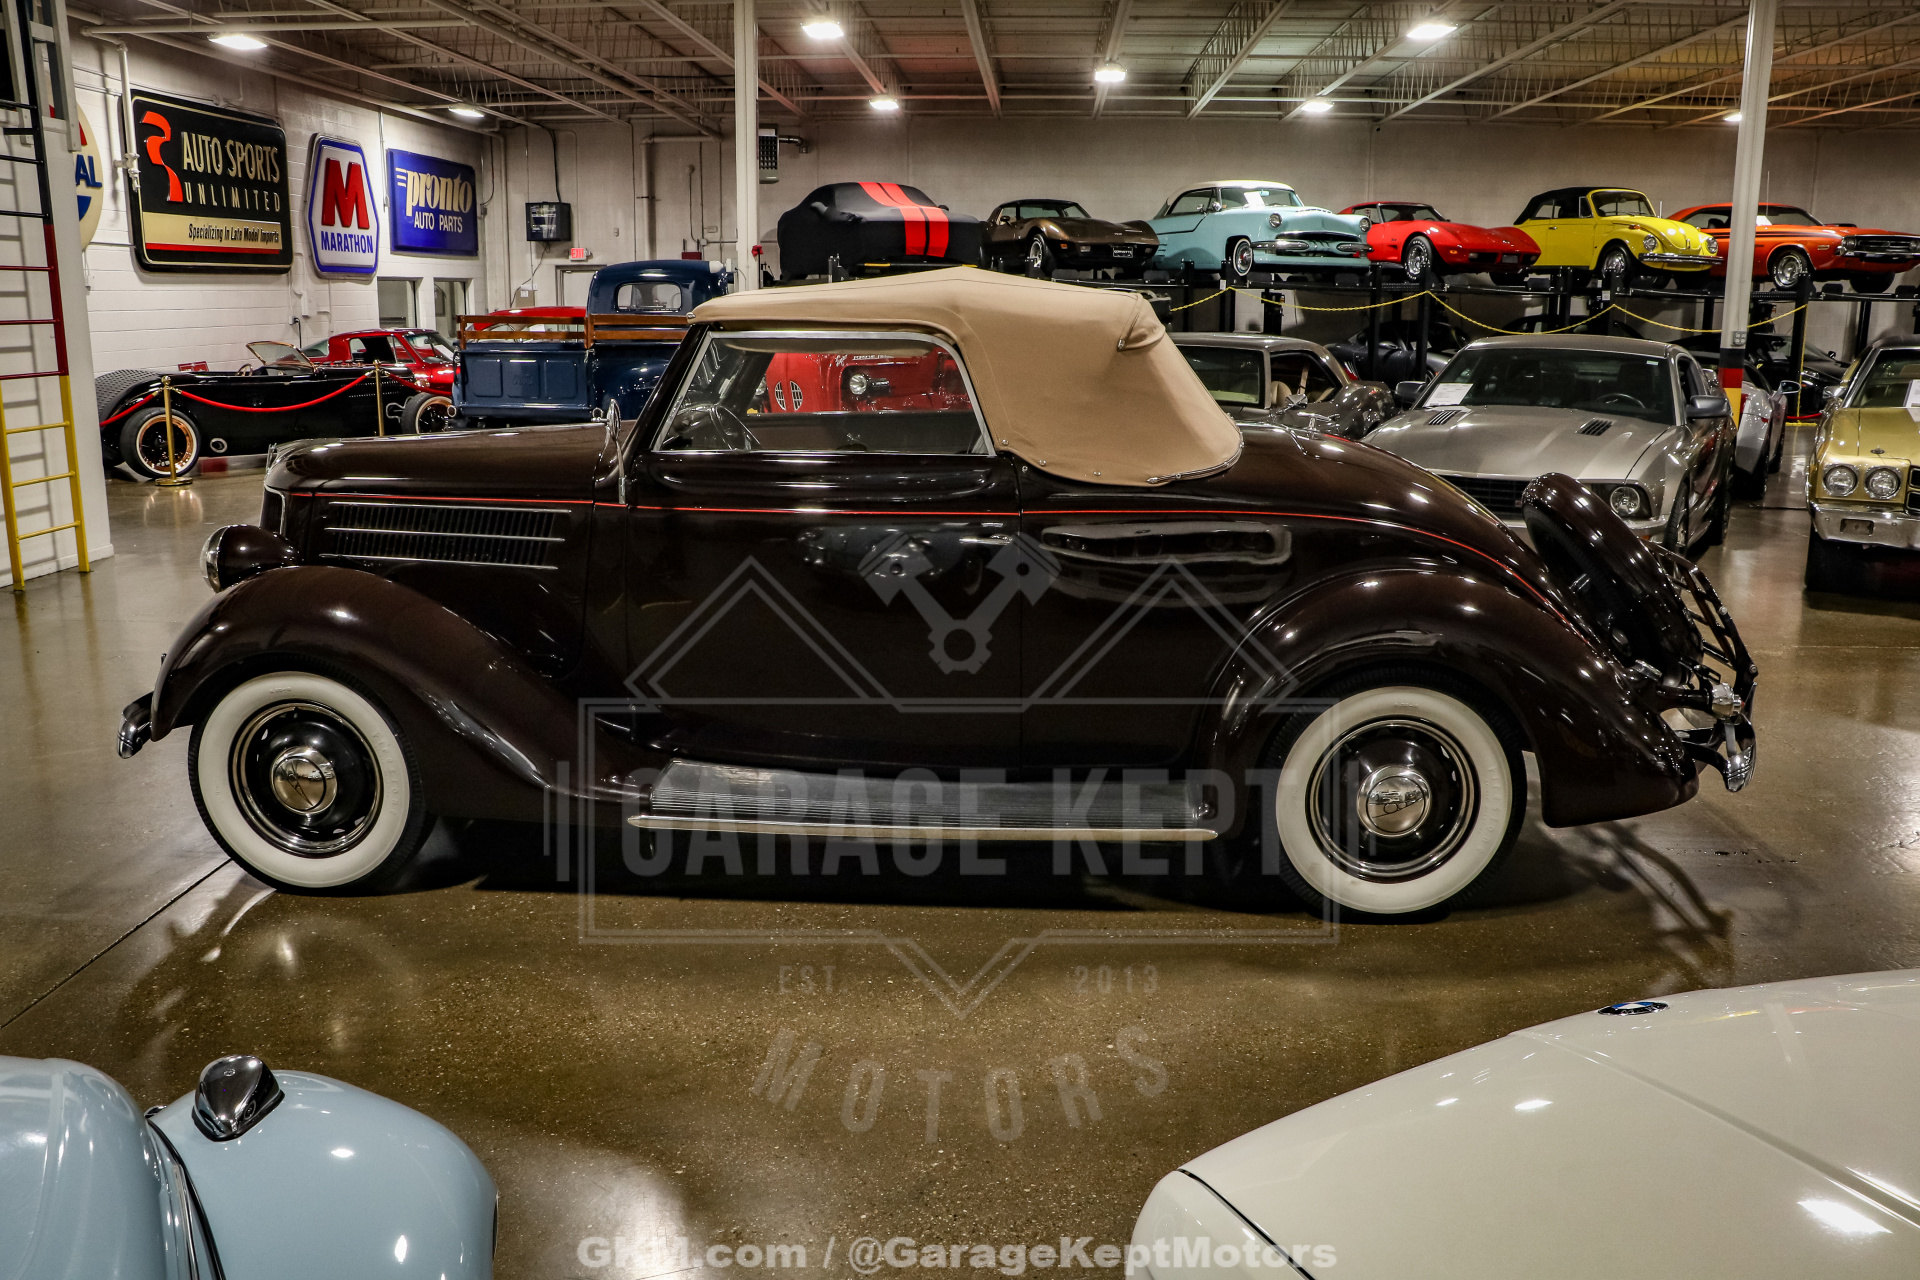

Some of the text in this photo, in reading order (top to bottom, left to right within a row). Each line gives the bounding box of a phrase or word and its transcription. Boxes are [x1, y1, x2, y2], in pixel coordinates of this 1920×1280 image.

[181, 131, 280, 184] AUTO SPORTS
[184, 182, 280, 212] UNLIMITED
[321, 157, 370, 230] M
[405, 170, 473, 217] pronto
[188, 223, 223, 242] Specializing
[230, 226, 242, 241] Late
[243, 226, 259, 242] Model
[260, 228, 279, 244] Imports
[414, 212, 463, 233] AUTO PARTS
[321, 231, 374, 254] MARATHON
[571, 248, 584, 258] EXIT
